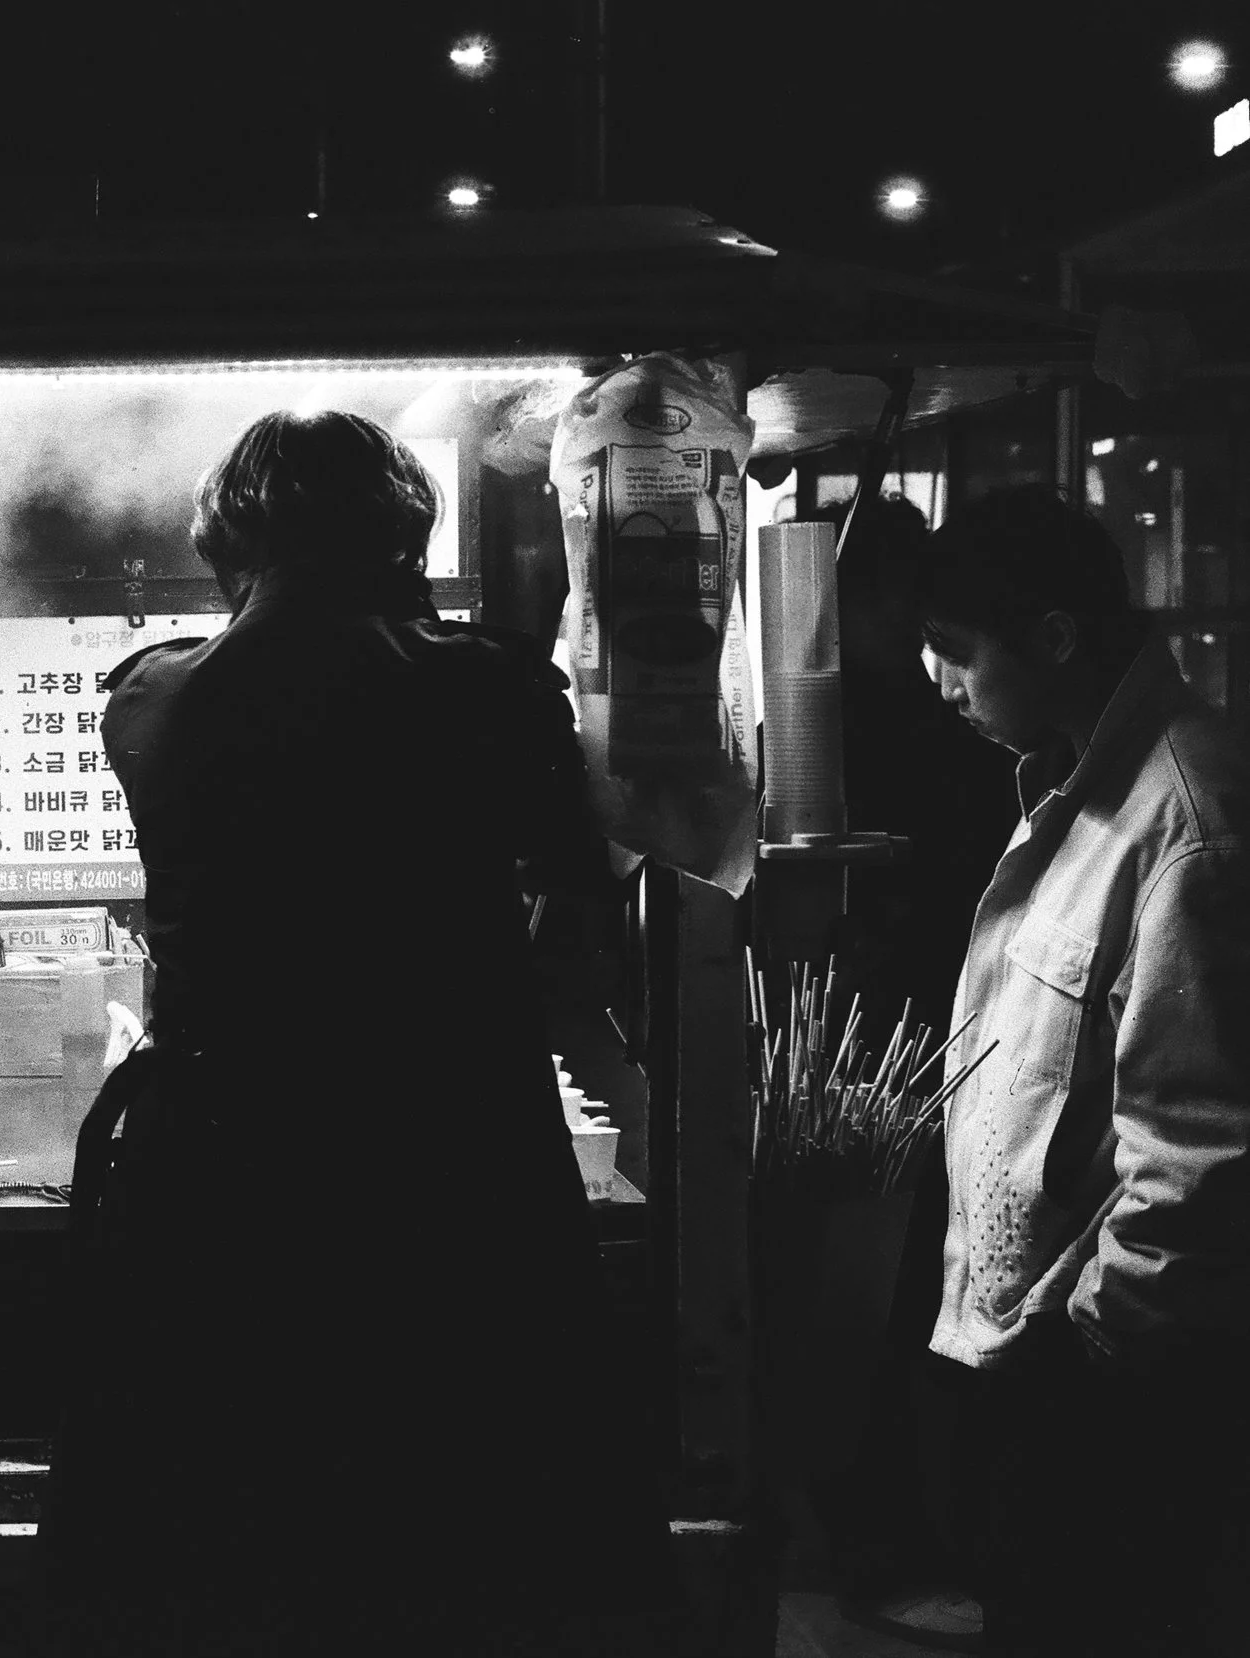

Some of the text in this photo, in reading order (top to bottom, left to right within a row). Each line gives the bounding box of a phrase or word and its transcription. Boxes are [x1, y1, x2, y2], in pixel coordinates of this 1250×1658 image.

[17, 673, 83, 694] 고추장
[22, 713, 65, 734] 간장
[77, 712, 102, 734] 닭
[23, 752, 65, 773] 소금
[24, 791, 89, 812] 바비큐
[102, 790, 129, 812] 닭
[24, 830, 90, 852] 매운맛
[8, 929, 52, 946] FOIL
[60, 934, 77, 946] 30
